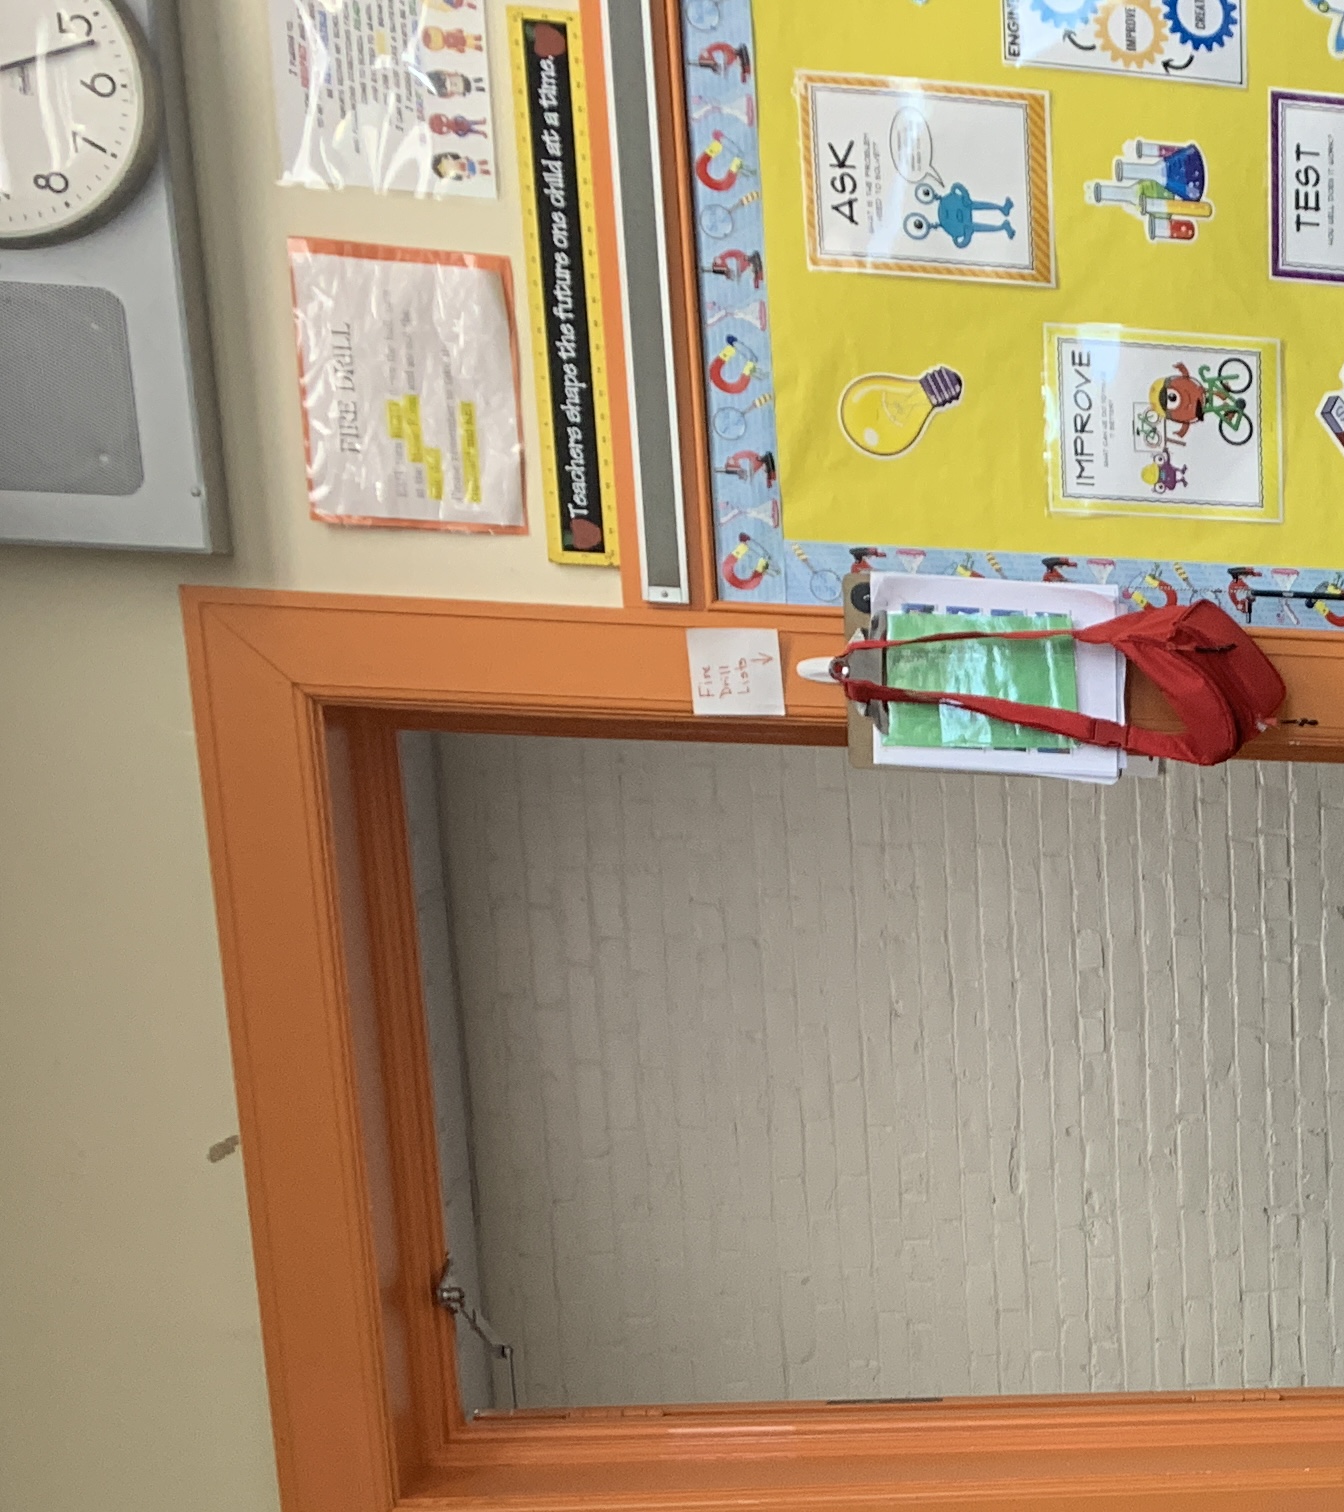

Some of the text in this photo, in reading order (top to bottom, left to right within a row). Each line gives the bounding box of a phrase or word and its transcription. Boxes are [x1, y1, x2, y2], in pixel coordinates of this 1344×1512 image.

[56, 10, 92, 37] 5
[1125, 6, 1137, 51] IMPROVE
[80, 71, 117, 98] 6
[71, 130, 108, 153] 7
[33, 171, 69, 194] 8
[827, 138, 859, 226] ASK
[1295, 142, 1321, 232] TEST
[538, 53, 588, 519] Teachers shape the future one child at a time.
[331, 321, 361, 453] FIRE DRILL
[1071, 349, 1095, 486] IMPROVE
[698, 664, 715, 698] Fire
[719, 664, 732, 699] Drill
[734, 657, 751, 695] Lists
